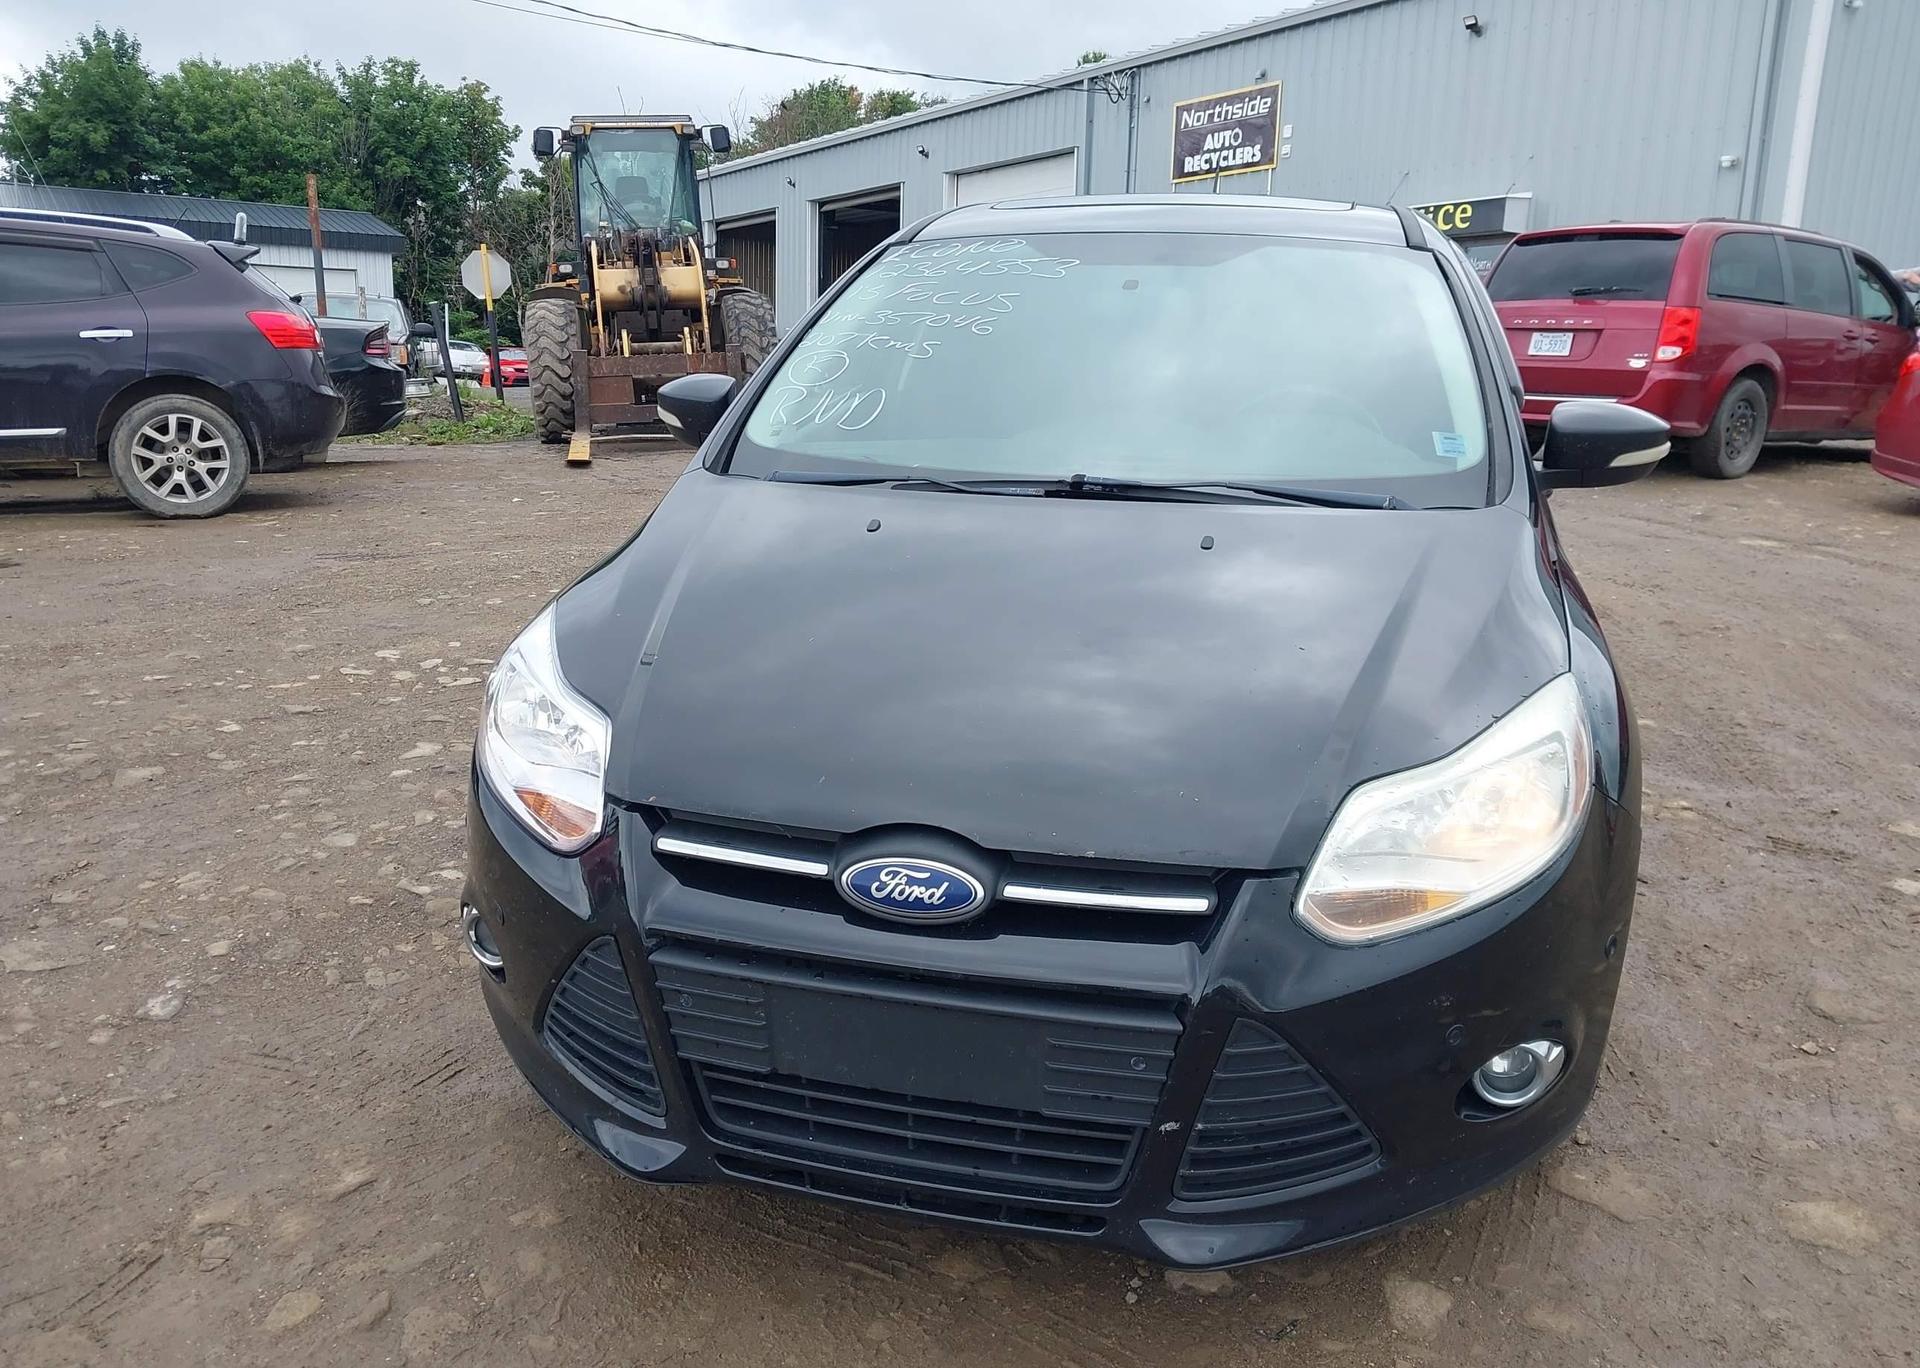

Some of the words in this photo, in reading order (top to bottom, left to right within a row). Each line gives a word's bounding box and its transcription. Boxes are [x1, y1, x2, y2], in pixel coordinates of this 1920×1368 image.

[1180, 95, 1272, 129] Northside
[1203, 127, 1243, 151] AUTO
[1183, 144, 1262, 173] RECYCLERS
[870, 866, 950, 905] Ford
